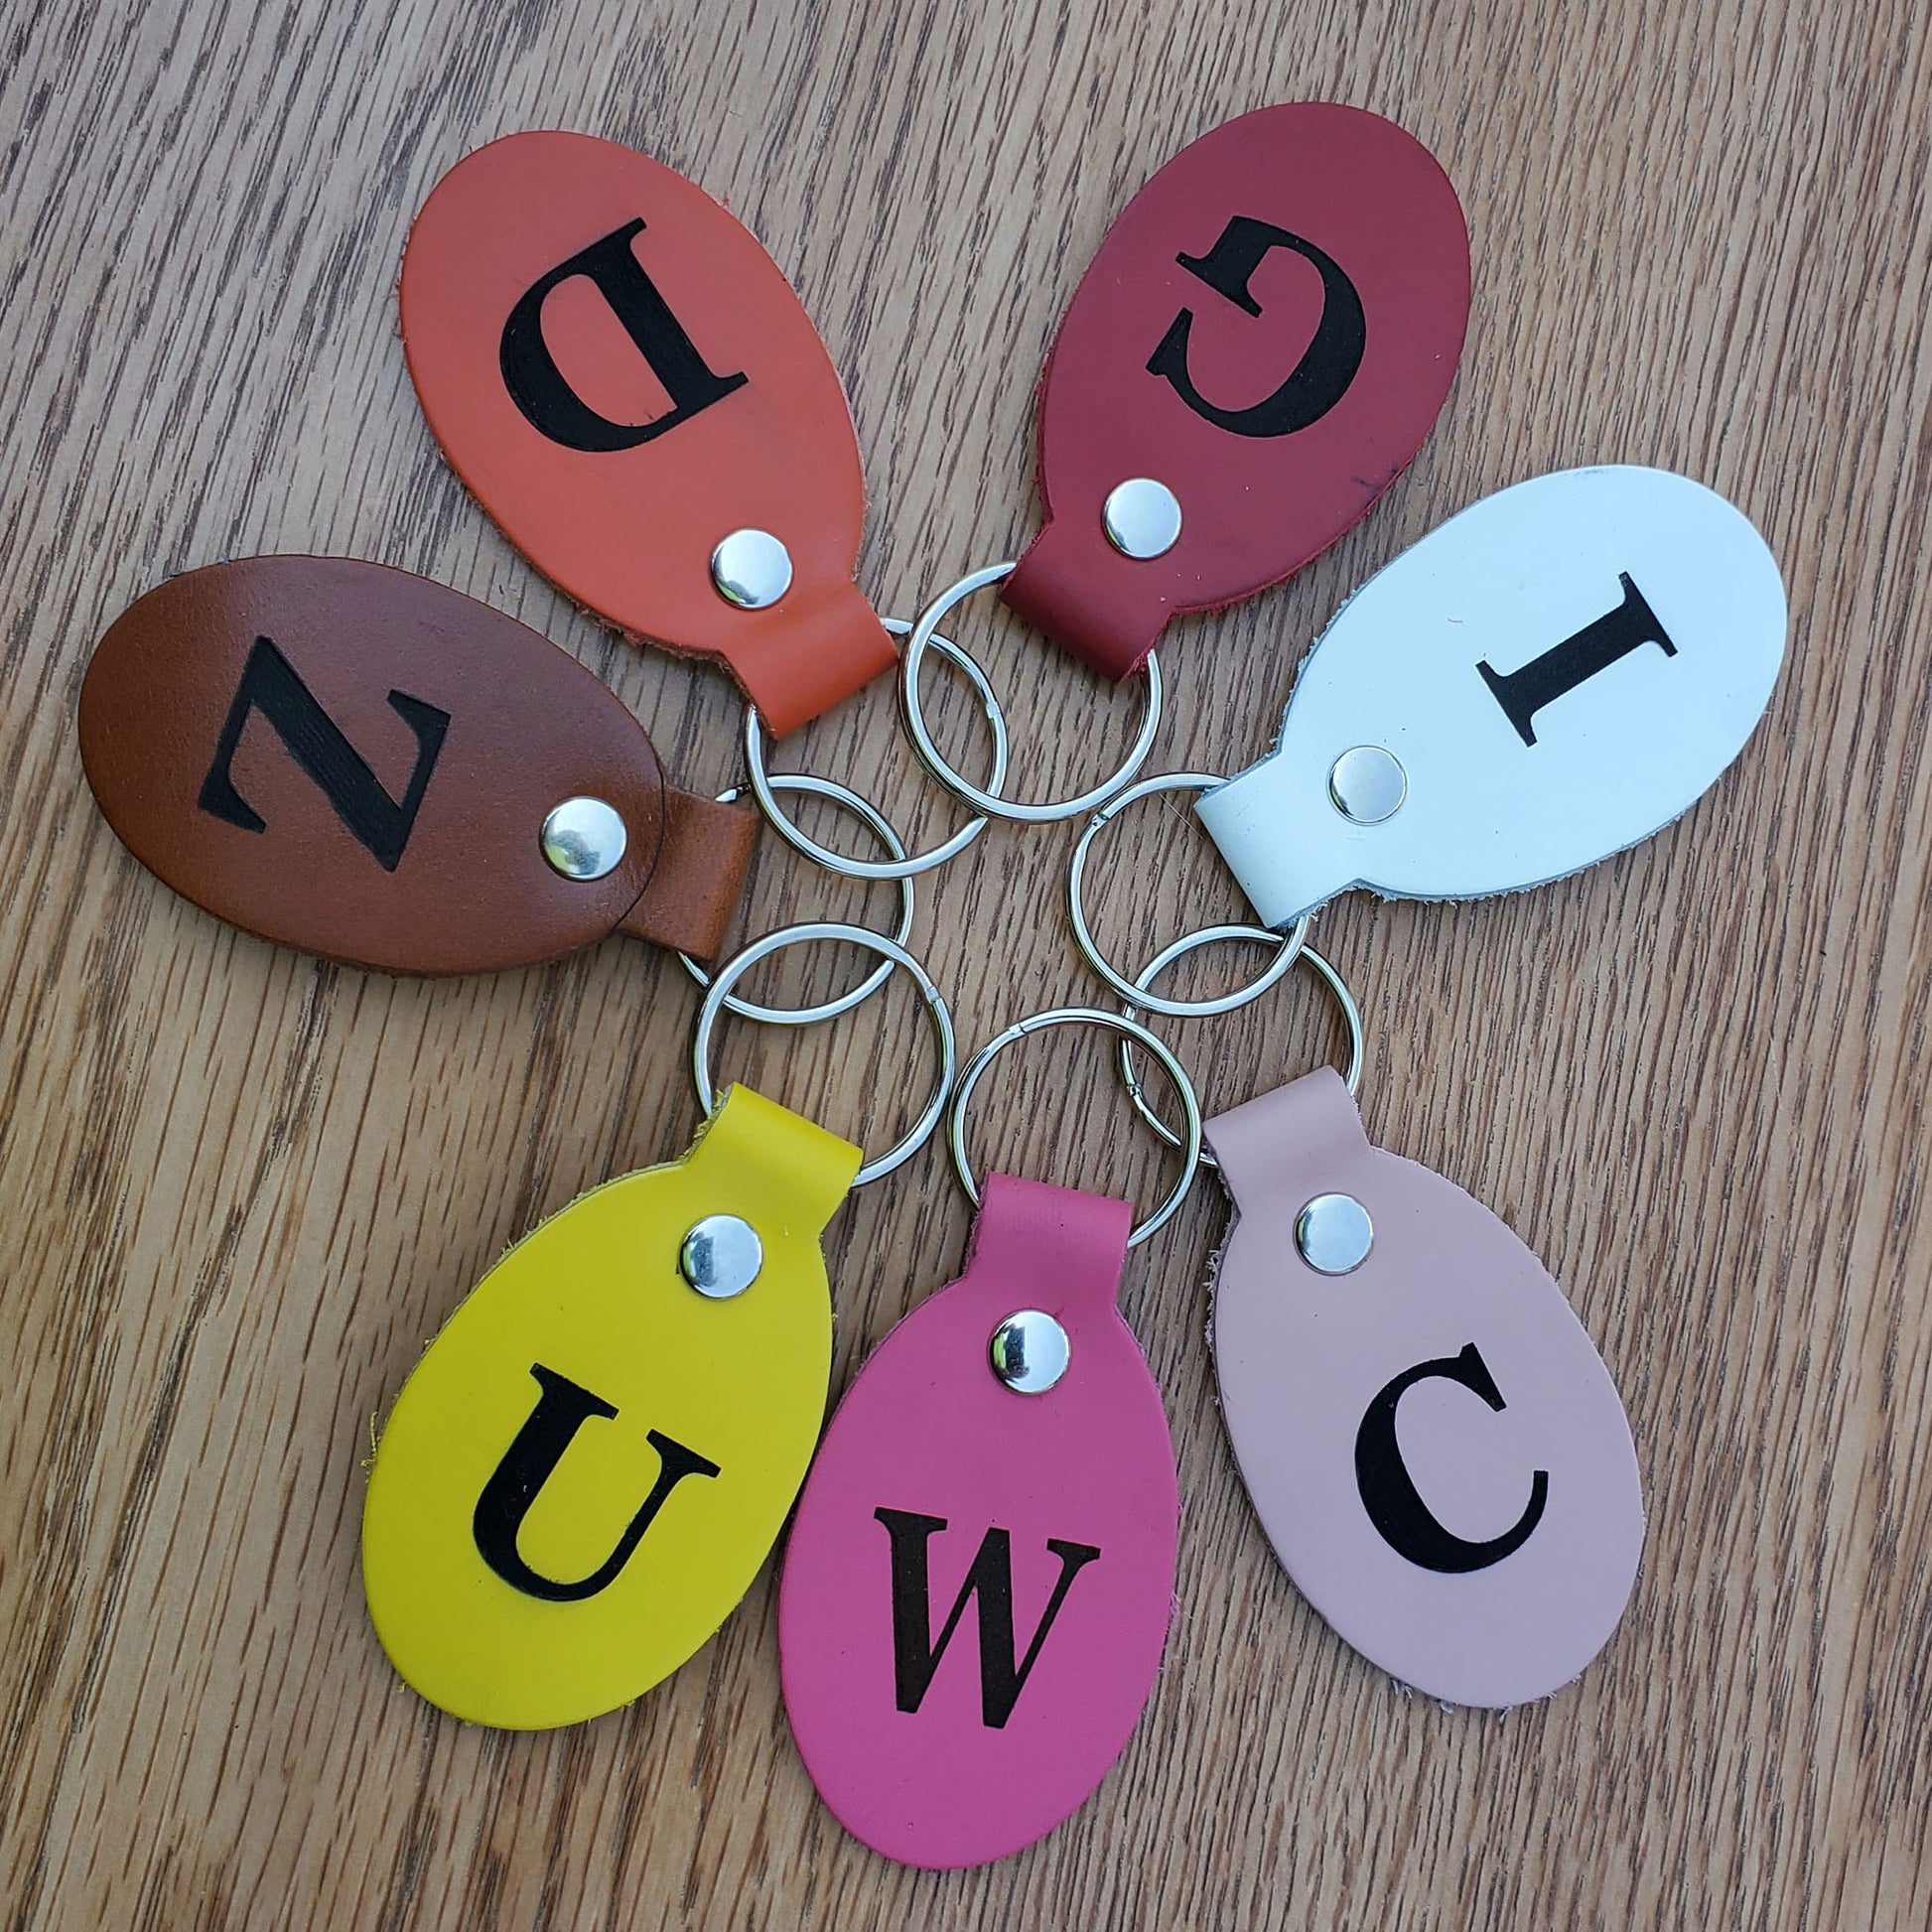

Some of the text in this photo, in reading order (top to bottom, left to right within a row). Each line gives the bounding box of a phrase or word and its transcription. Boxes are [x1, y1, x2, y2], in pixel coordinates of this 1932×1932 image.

[499, 217, 749, 452] D
[1146, 215, 1366, 438] G
[196, 635, 451, 873] Z
[1475, 572, 1678, 747] I
[473, 1363, 721, 1601] U
[1355, 1342, 1548, 1574] C
[874, 1507, 1101, 1728] W
